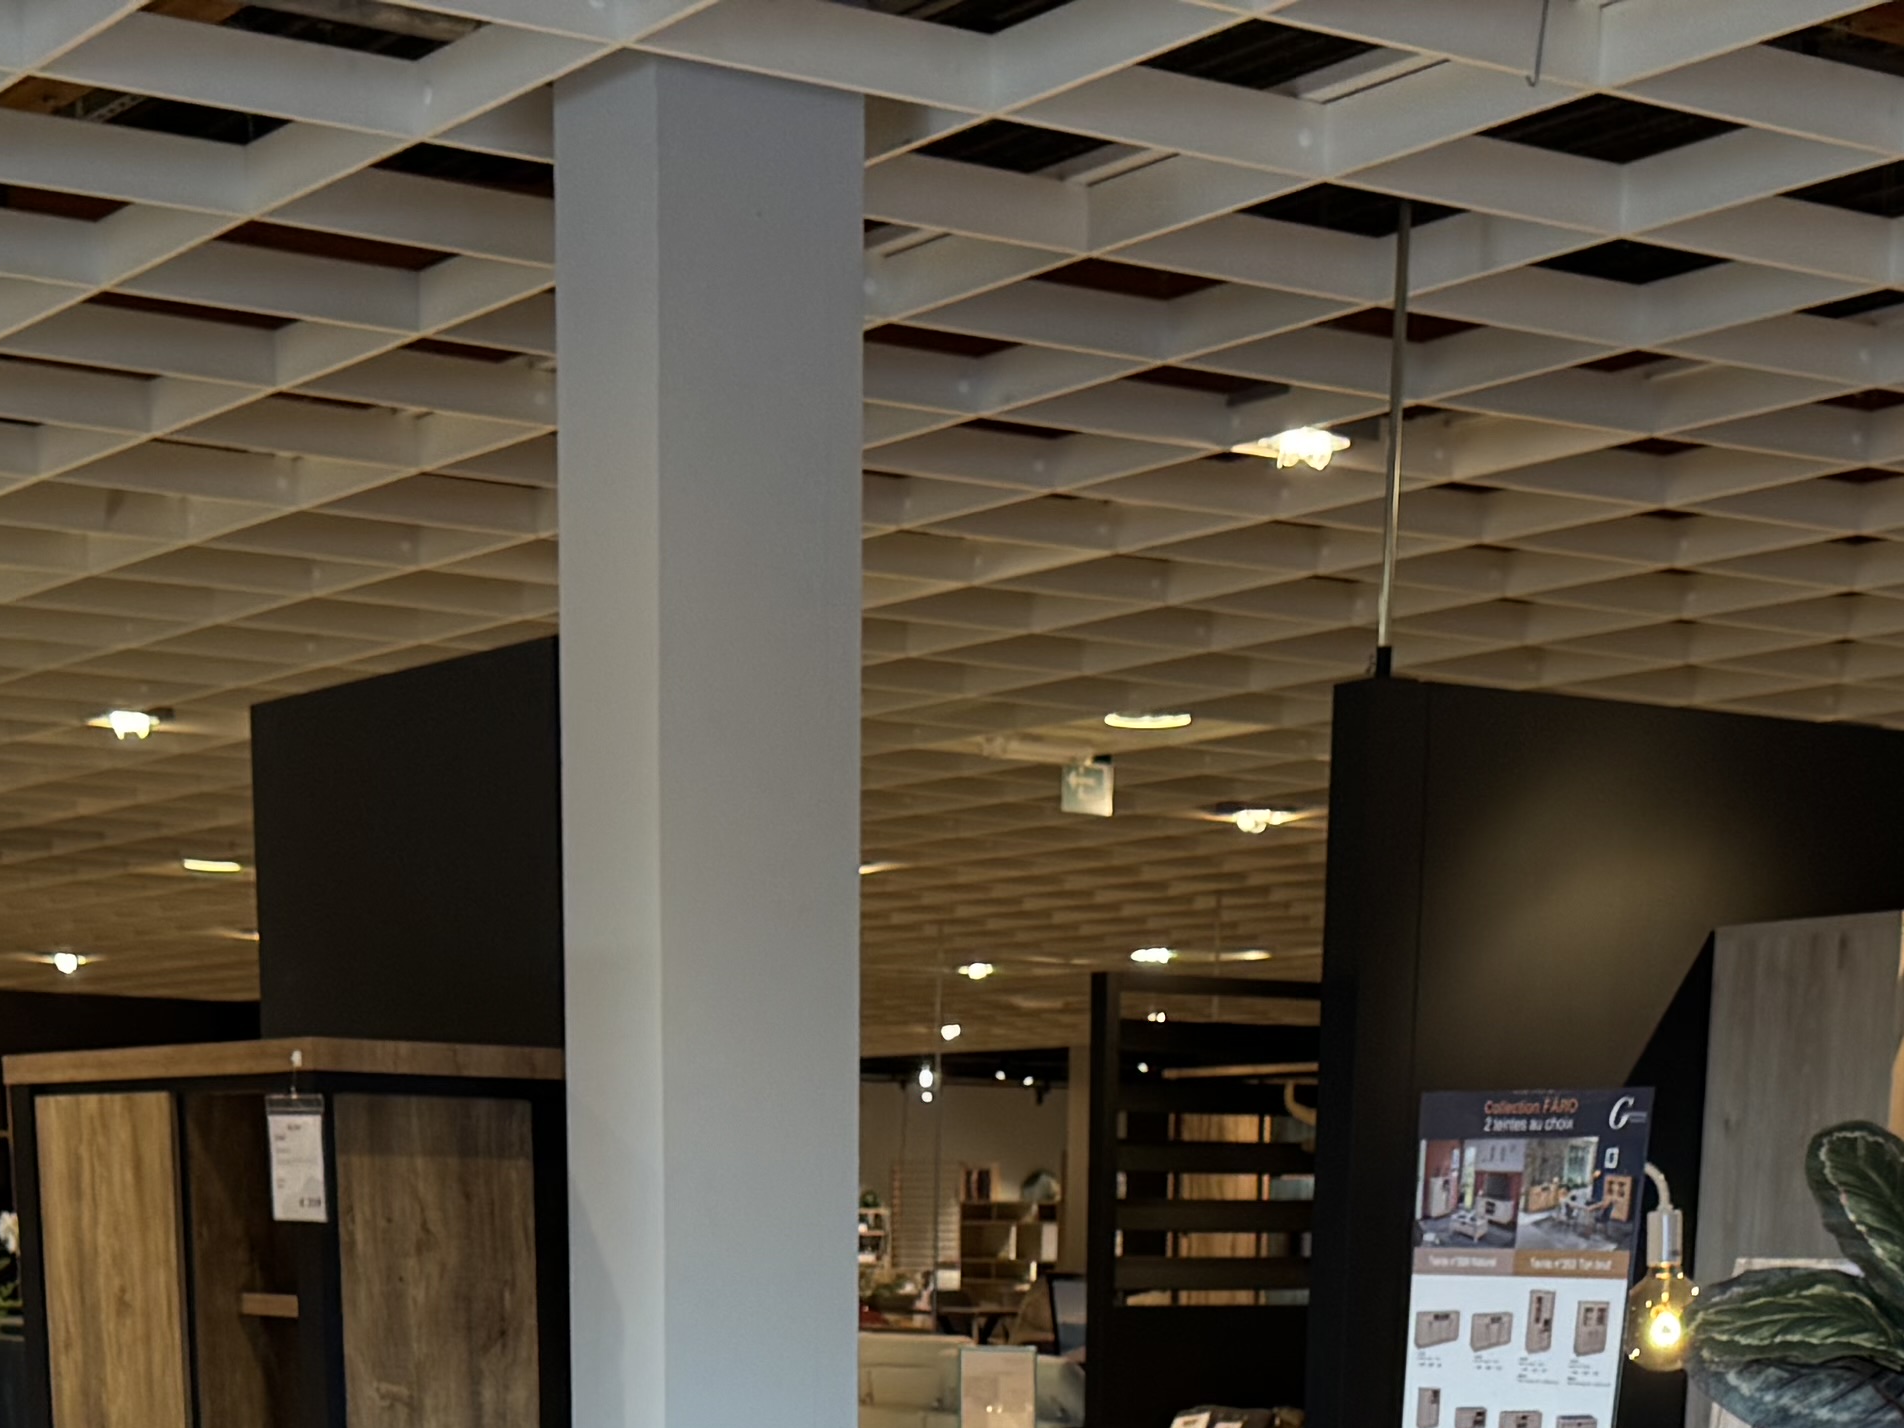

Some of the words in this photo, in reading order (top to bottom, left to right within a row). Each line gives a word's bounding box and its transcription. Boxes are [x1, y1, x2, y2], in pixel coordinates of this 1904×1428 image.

[1483, 1117, 1491, 1132] 2
[1493, 1117, 1528, 1132] teintes
[1529, 1118, 1542, 1132] au
[1544, 1117, 1575, 1131] choix
